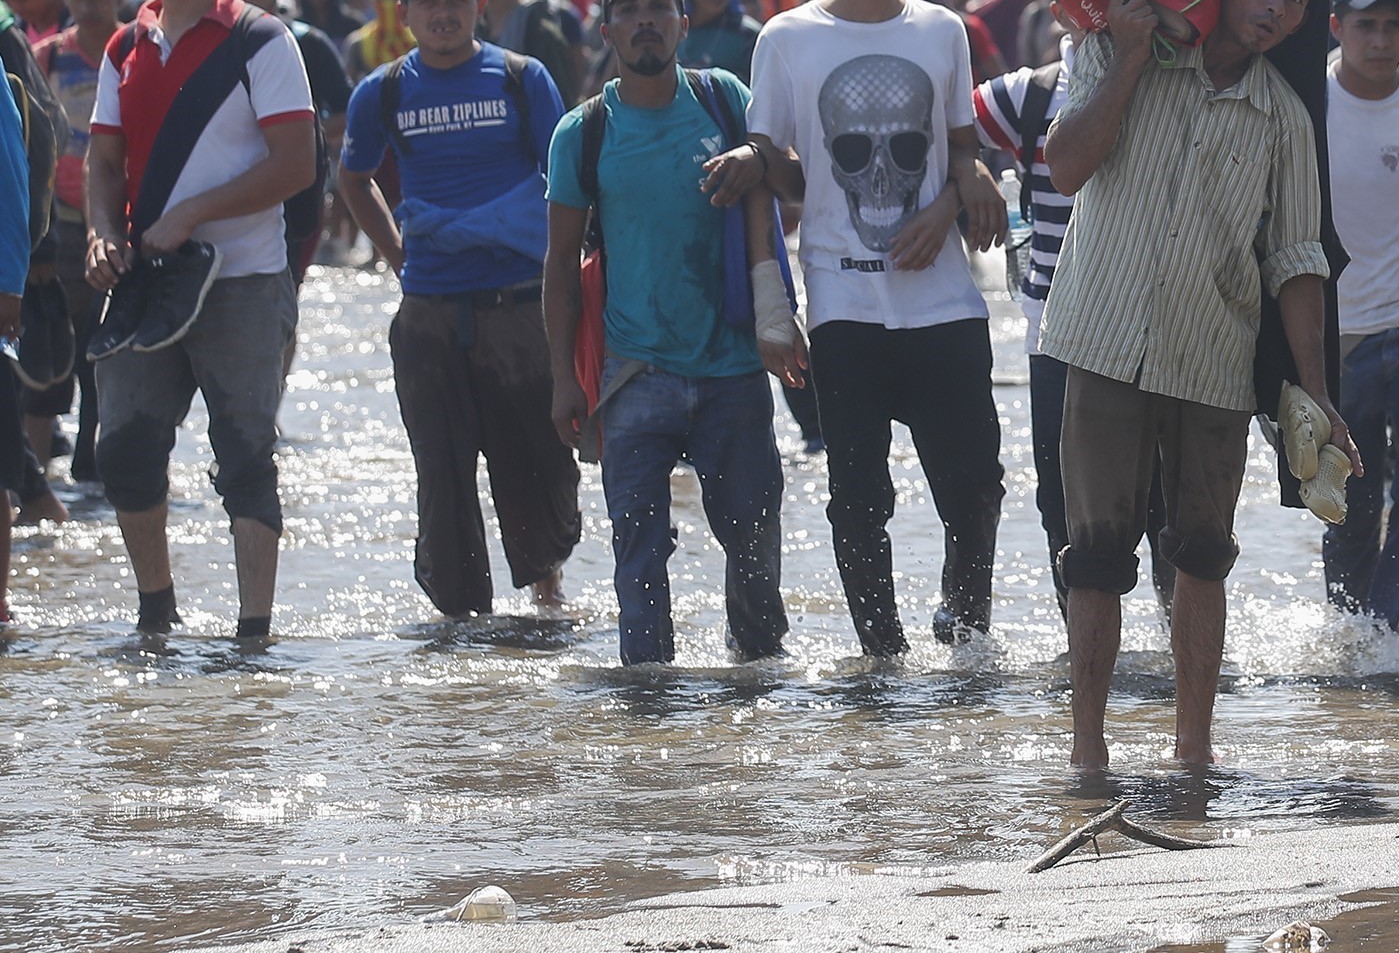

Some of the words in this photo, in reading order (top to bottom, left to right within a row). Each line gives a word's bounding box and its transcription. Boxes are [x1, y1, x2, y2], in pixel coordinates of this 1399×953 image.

[397, 110, 416, 130] BIG
[419, 106, 450, 125] BEAR
[453, 99, 507, 121] ZIPLINES
